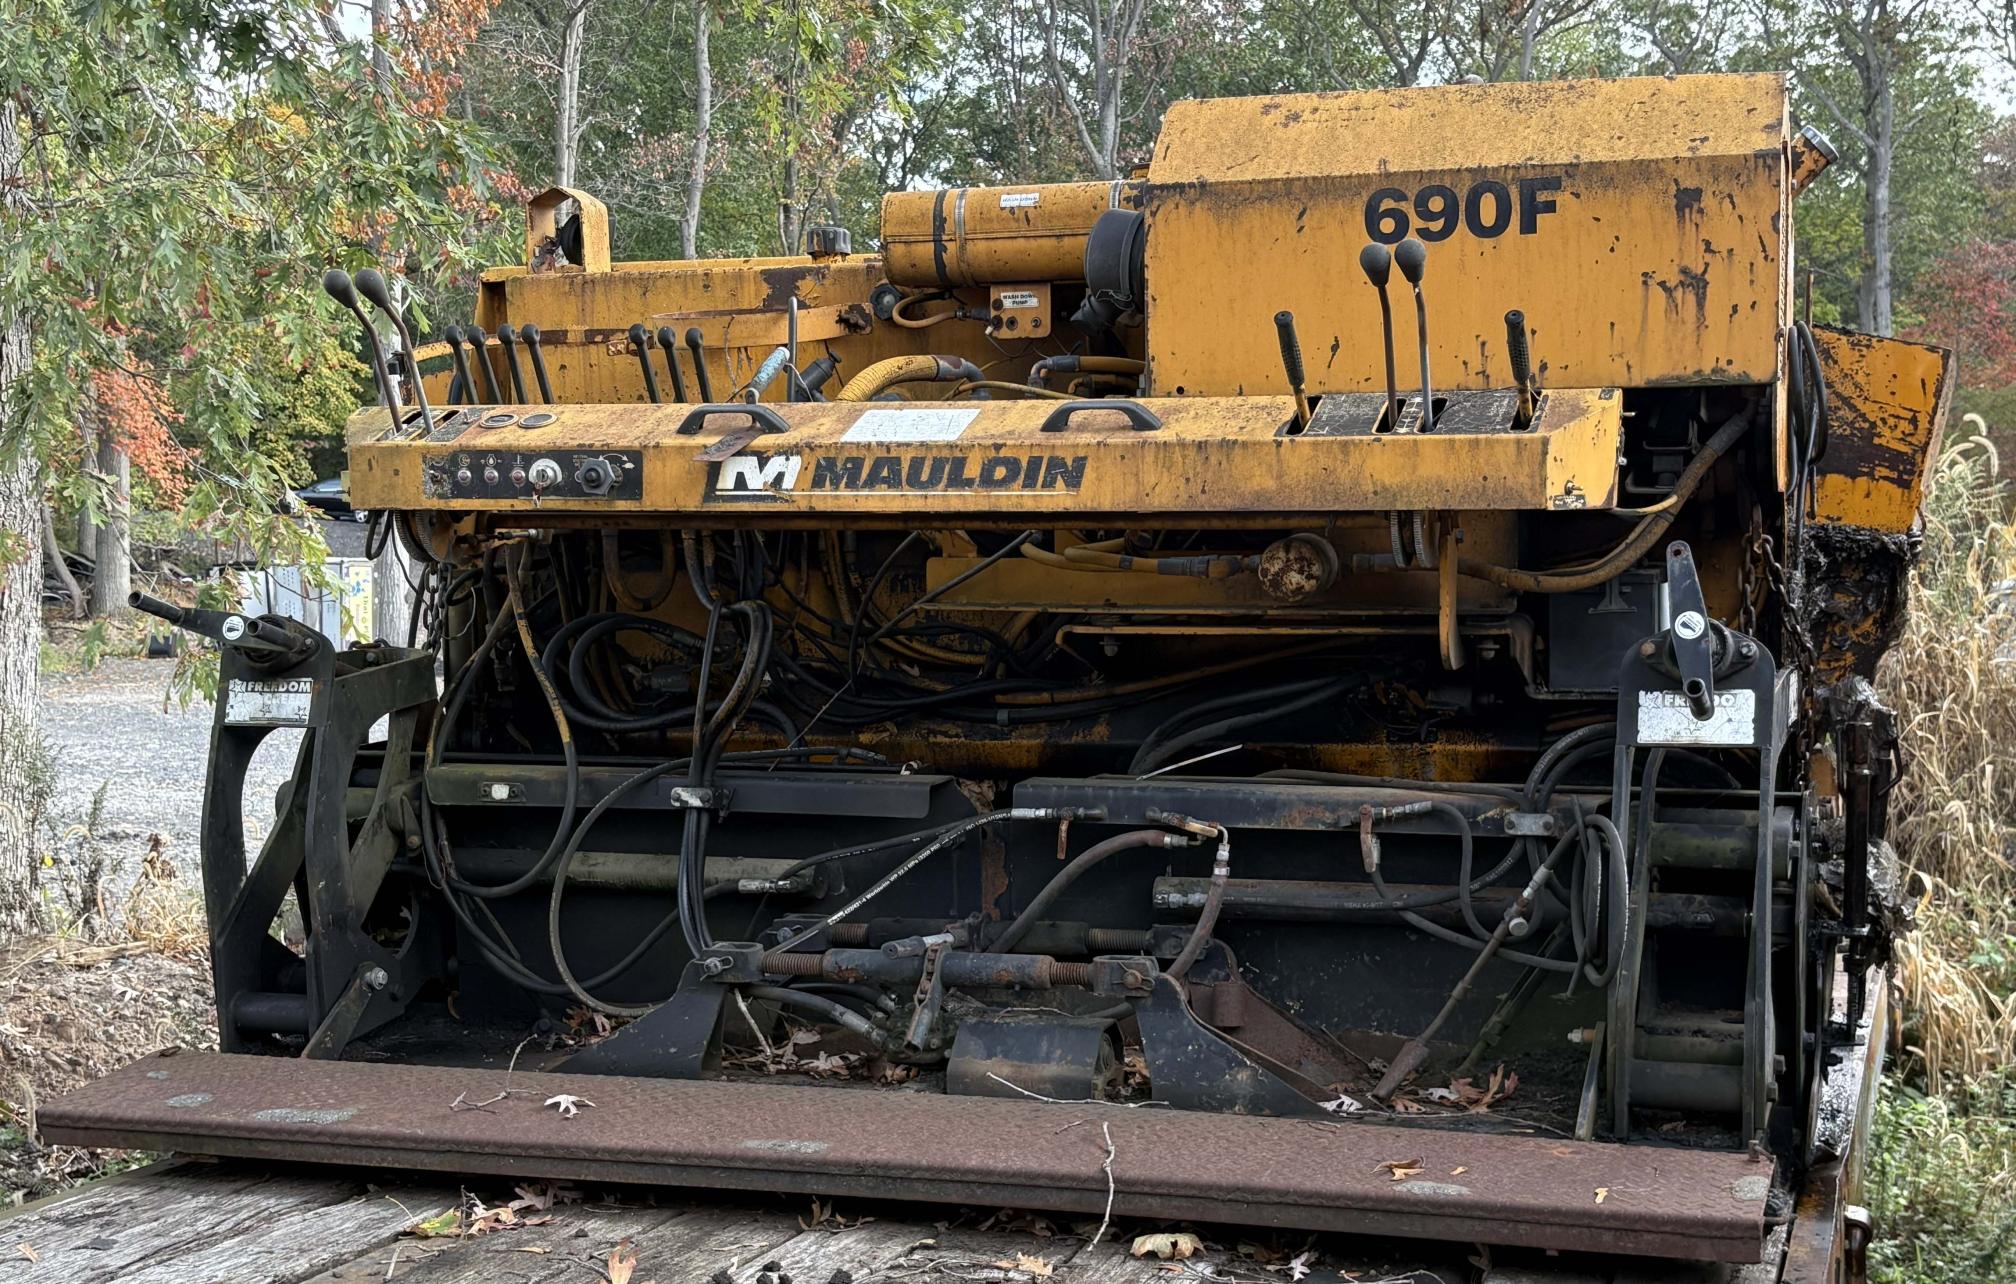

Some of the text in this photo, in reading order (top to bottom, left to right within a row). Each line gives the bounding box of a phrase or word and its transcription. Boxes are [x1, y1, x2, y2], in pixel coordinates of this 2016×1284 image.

[1364, 176, 1562, 244] 690F
[810, 455, 1088, 489] MAULDIN
[247, 681, 311, 692] FREEDOM
